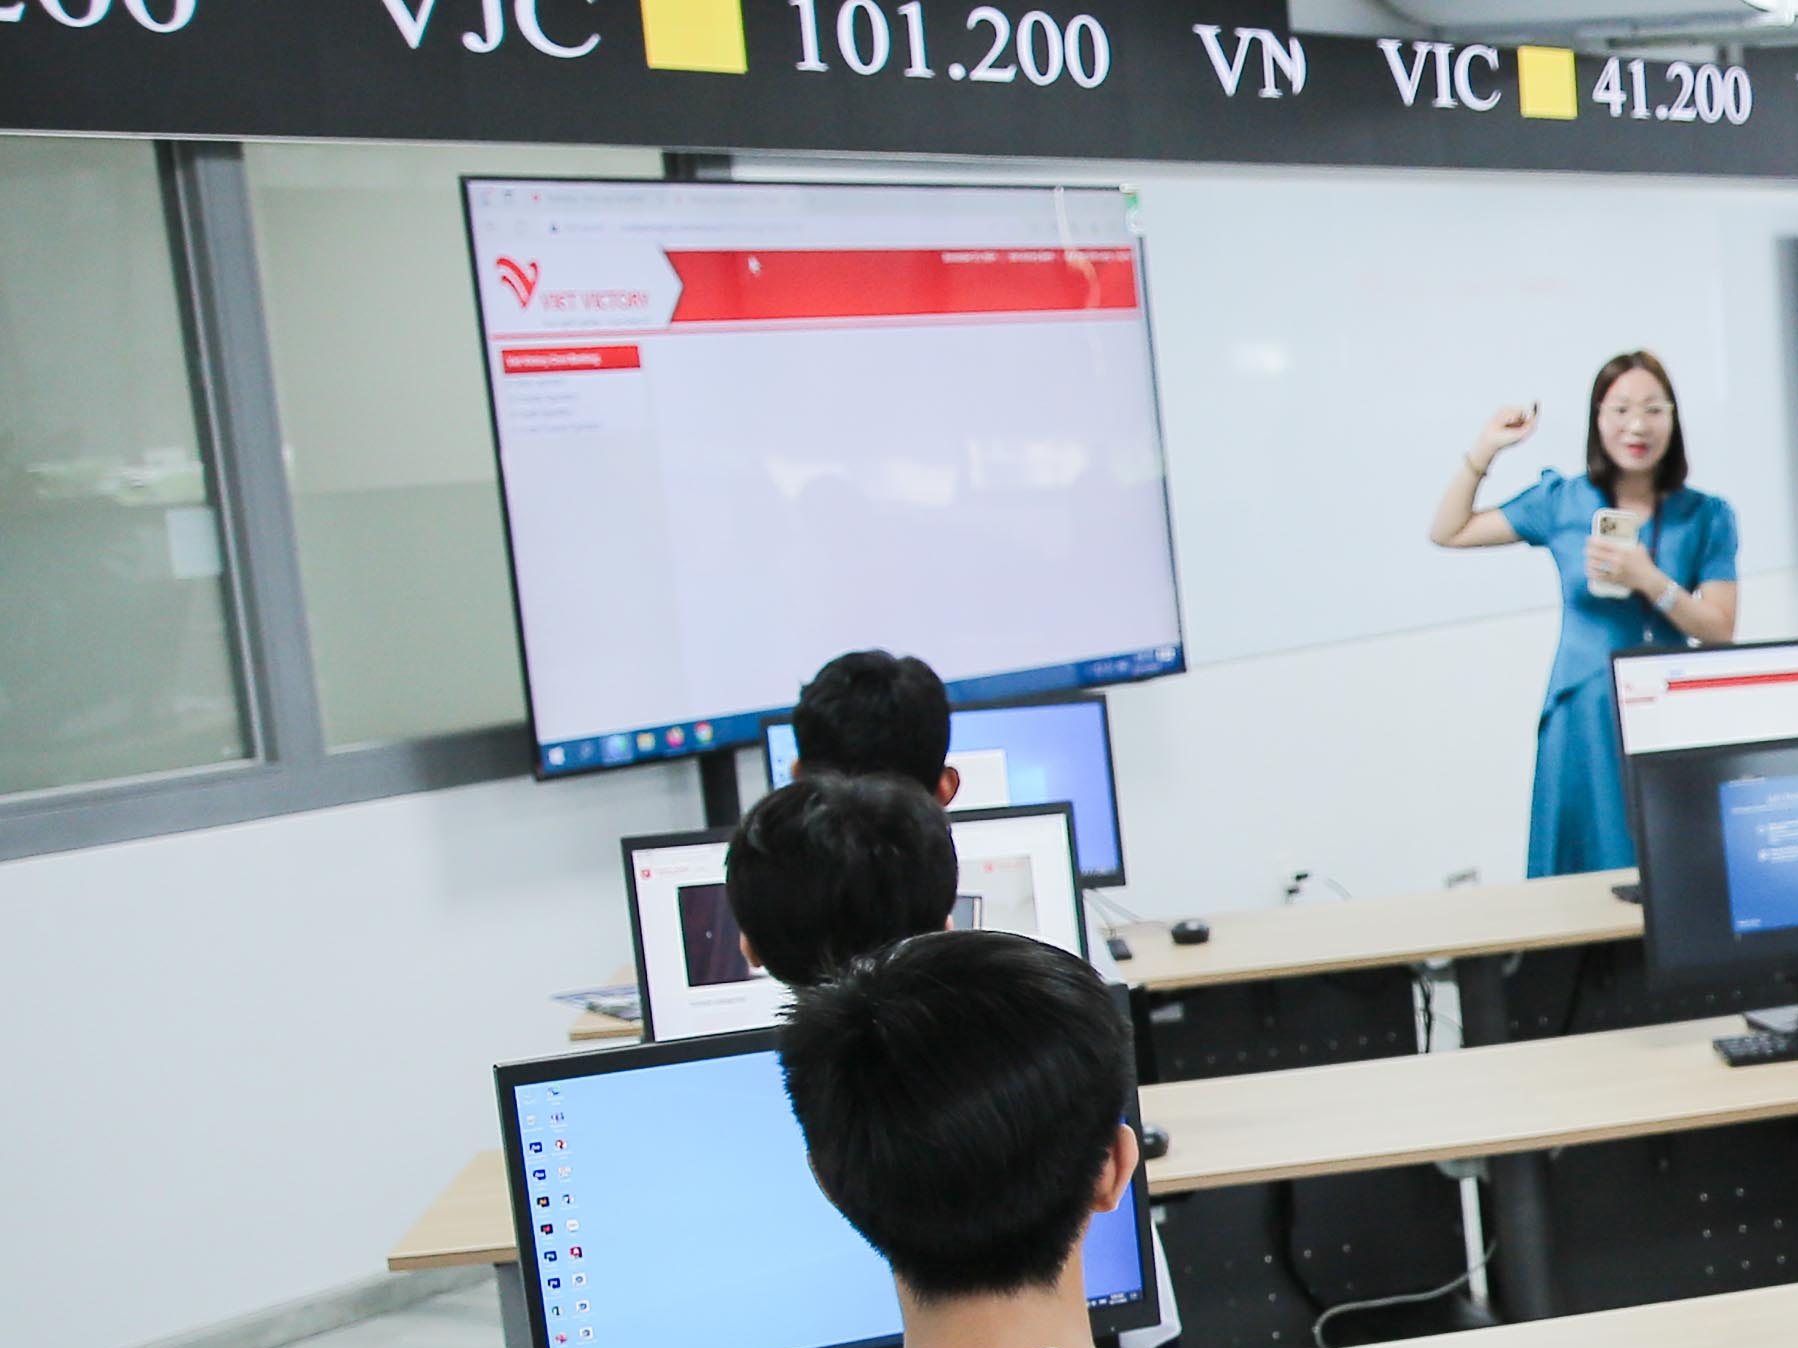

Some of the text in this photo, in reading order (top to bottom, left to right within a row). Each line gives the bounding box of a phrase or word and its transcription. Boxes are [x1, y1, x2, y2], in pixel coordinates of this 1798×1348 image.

[792, 0, 1111, 88] 101.200
[1377, 38, 1502, 111] VIC
[1593, 56, 1752, 125] 41.200
